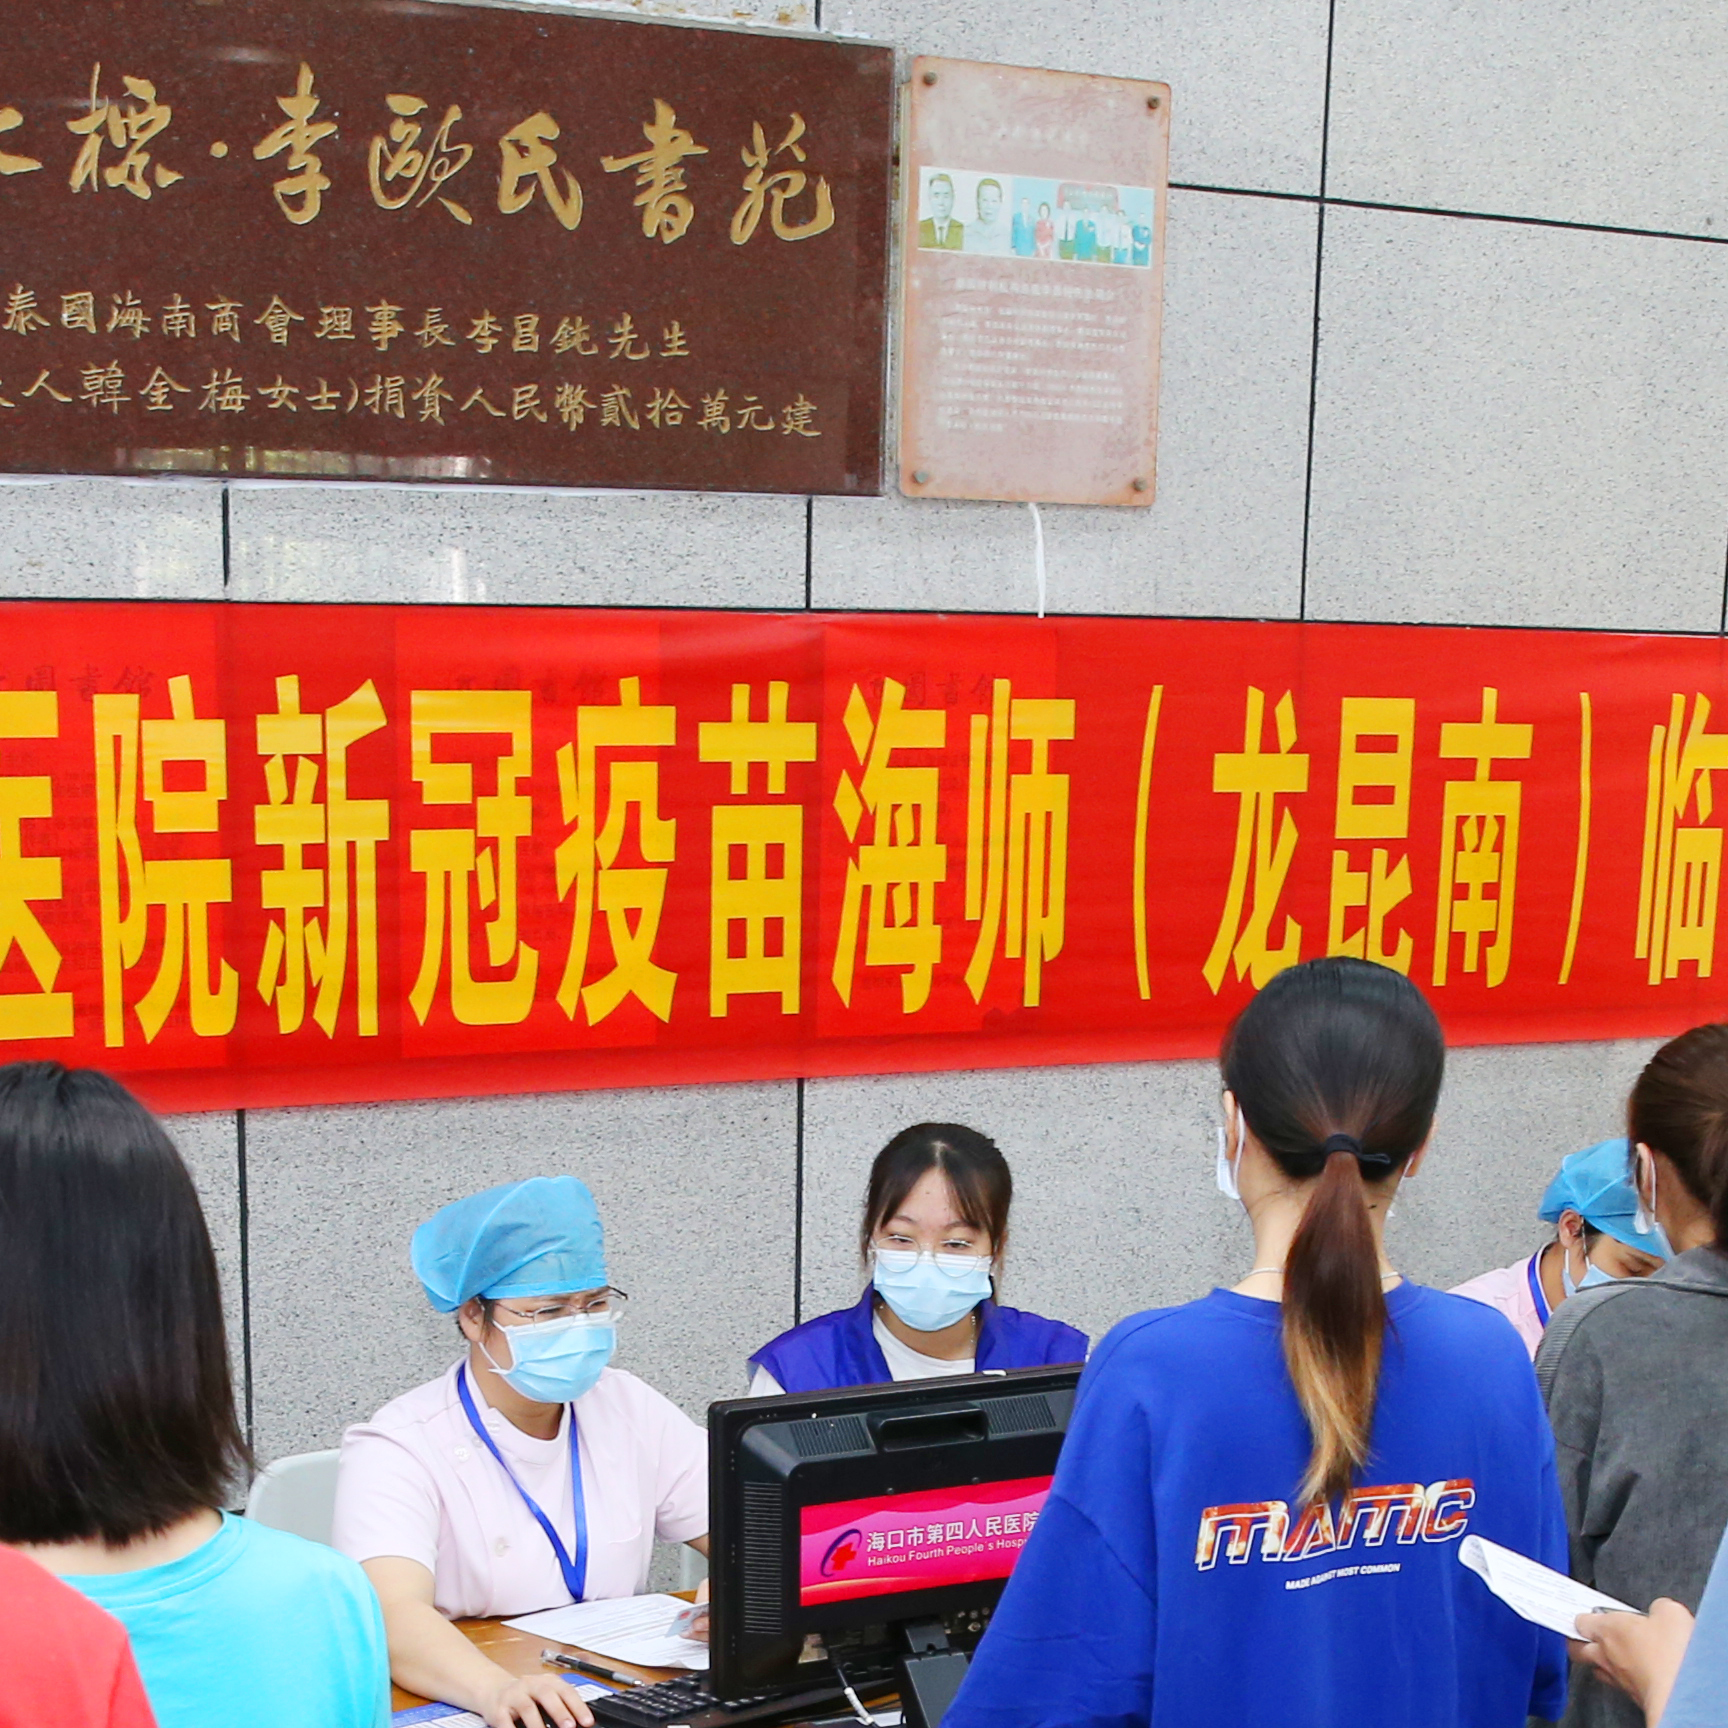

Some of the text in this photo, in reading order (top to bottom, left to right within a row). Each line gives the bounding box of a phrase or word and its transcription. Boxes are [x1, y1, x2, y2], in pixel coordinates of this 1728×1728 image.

[866, 1511, 1040, 1553] 海口市第四人民医院
[867, 1552, 907, 1567] Haikou
[908, 1544, 945, 1562] Fourth
